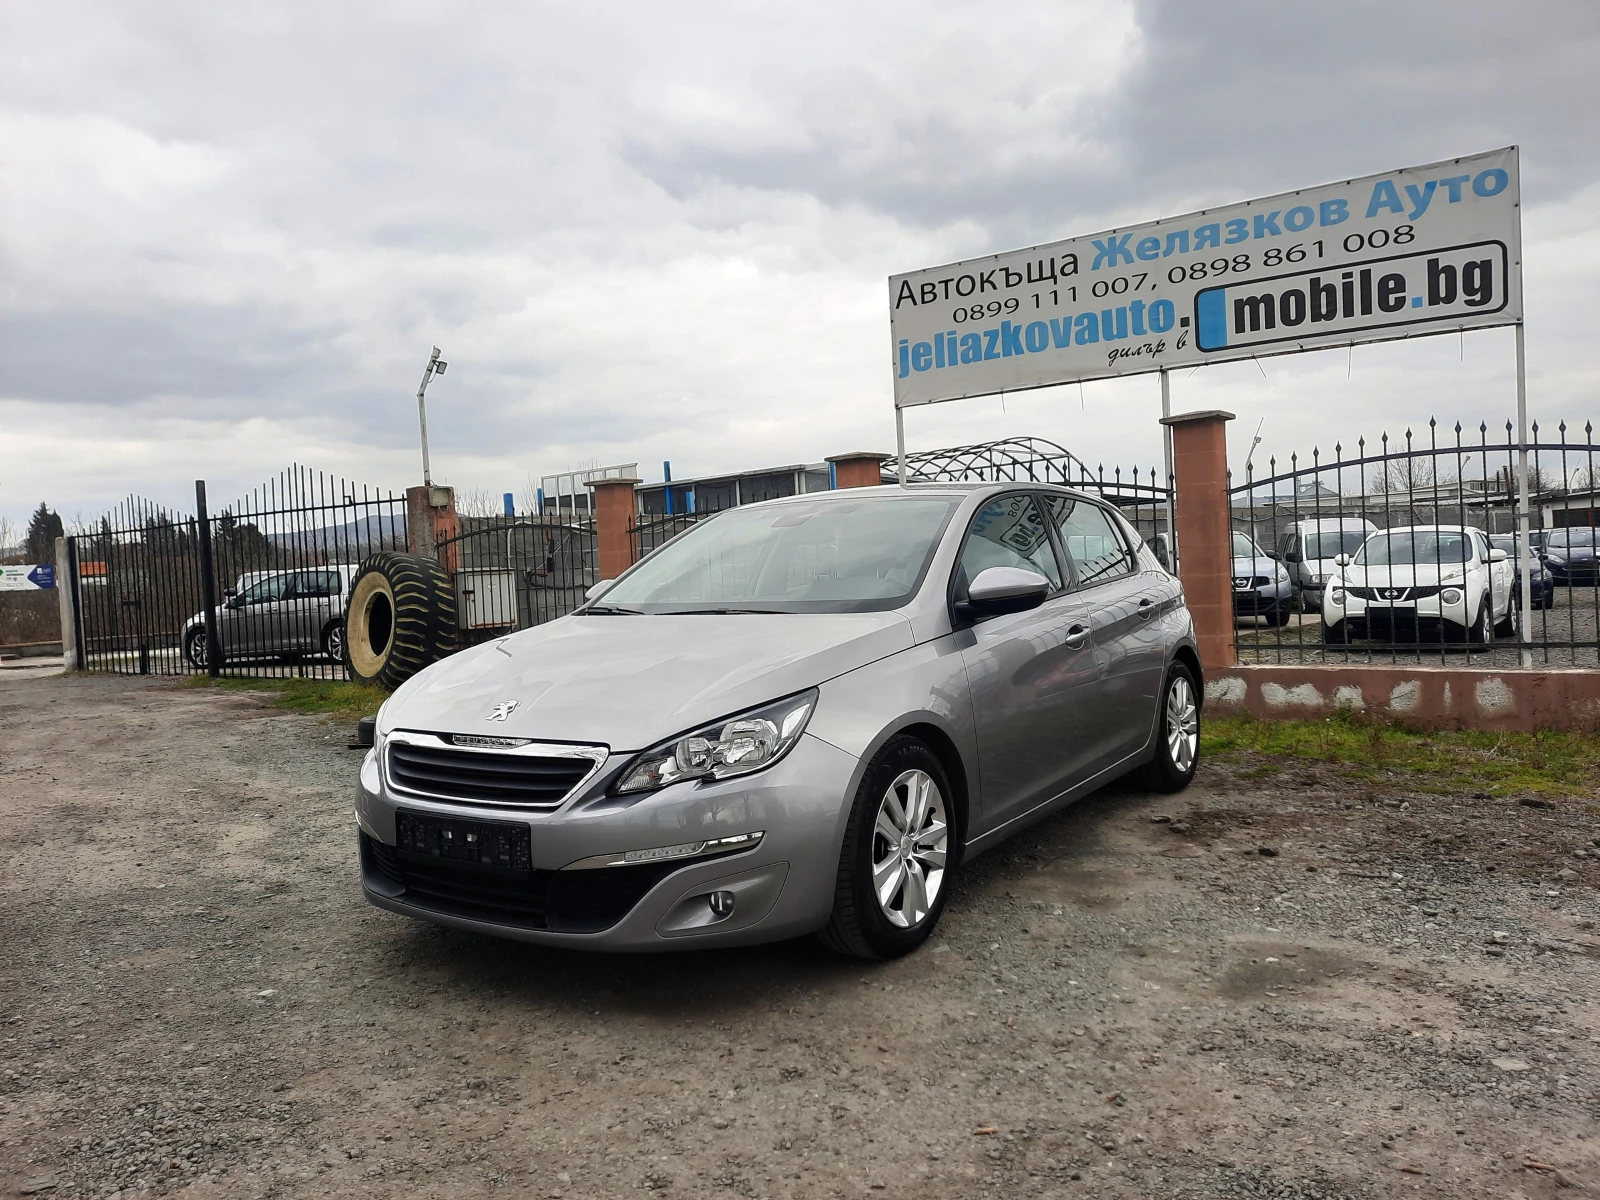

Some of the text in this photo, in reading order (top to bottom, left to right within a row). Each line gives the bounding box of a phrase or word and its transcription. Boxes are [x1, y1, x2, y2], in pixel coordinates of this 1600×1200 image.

[895, 168, 1509, 309] Автокъща Желязков Ауто
[952, 224, 1415, 323] 0899 111 007, 0898 861 008
[898, 257, 1493, 379] jeliazkovauto. mobile.bg
[1107, 329, 1189, 366] дилър в
